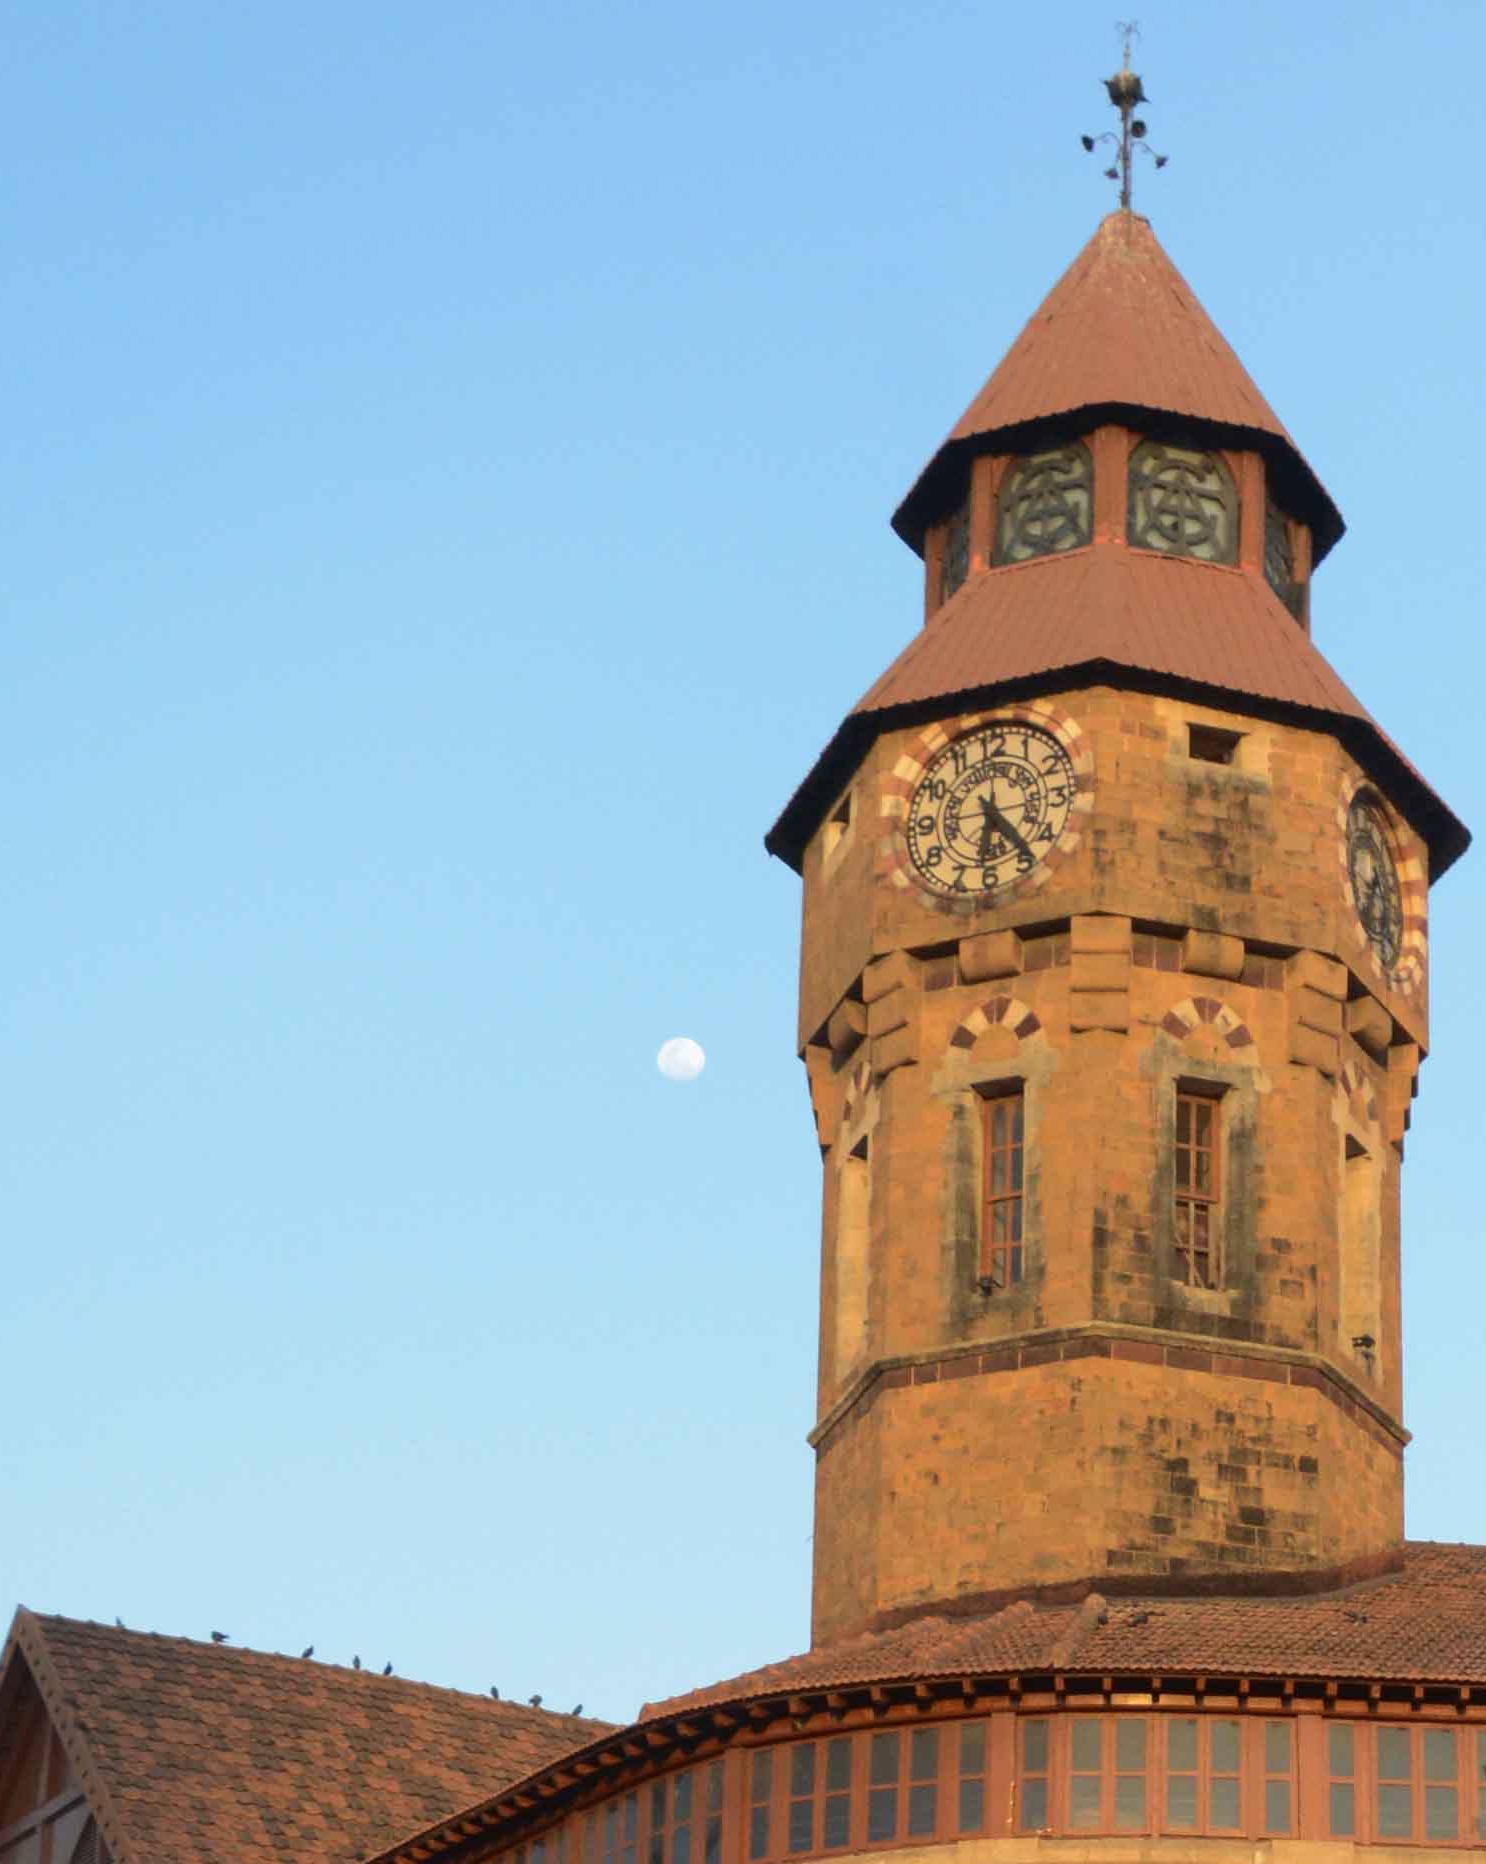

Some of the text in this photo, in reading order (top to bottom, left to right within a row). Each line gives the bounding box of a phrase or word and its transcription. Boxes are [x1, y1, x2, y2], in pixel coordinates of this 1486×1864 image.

[980, 735, 1007, 760] 12
[1023, 736, 1030, 760] 1
[952, 749, 967, 777] 11
[1042, 753, 1063, 775] 2
[926, 779, 947, 802] 10
[1050, 785, 1067, 807] 3
[917, 816, 934, 835] 9
[1039, 822, 1054, 841] 4
[927, 846, 942, 866] 8
[952, 864, 968, 891] 7
[982, 865, 999, 887] 6
